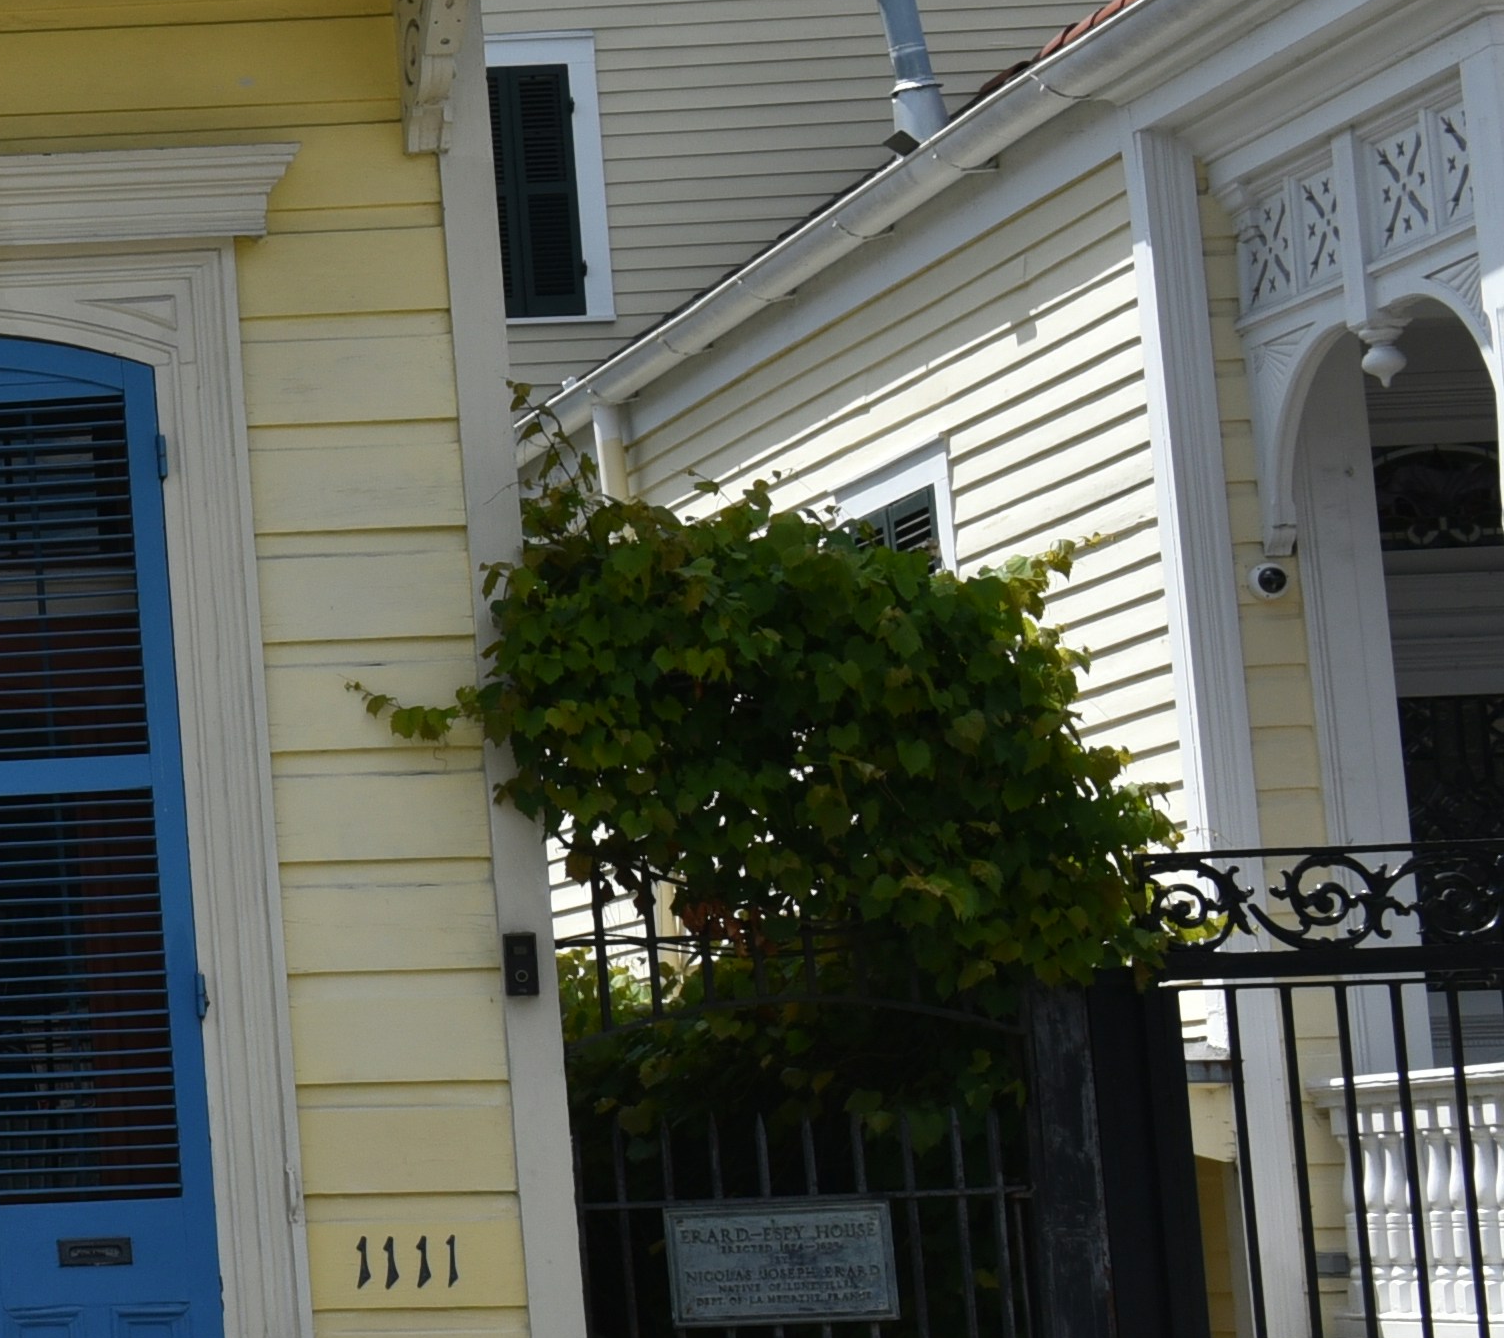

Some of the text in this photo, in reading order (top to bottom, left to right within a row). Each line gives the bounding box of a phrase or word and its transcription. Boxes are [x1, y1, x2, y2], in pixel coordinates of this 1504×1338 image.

[815, 1222, 876, 1239] HOUSE
[356, 1234, 459, 1290] 1111
[684, 1265, 880, 1284] NICOLAS JOSEPH ERARD
[719, 1283, 761, 1293] NATIVE
[768, 1283, 781, 1292] OF
[729, 1296, 742, 1305] OF
[749, 1295, 764, 1304] LA
